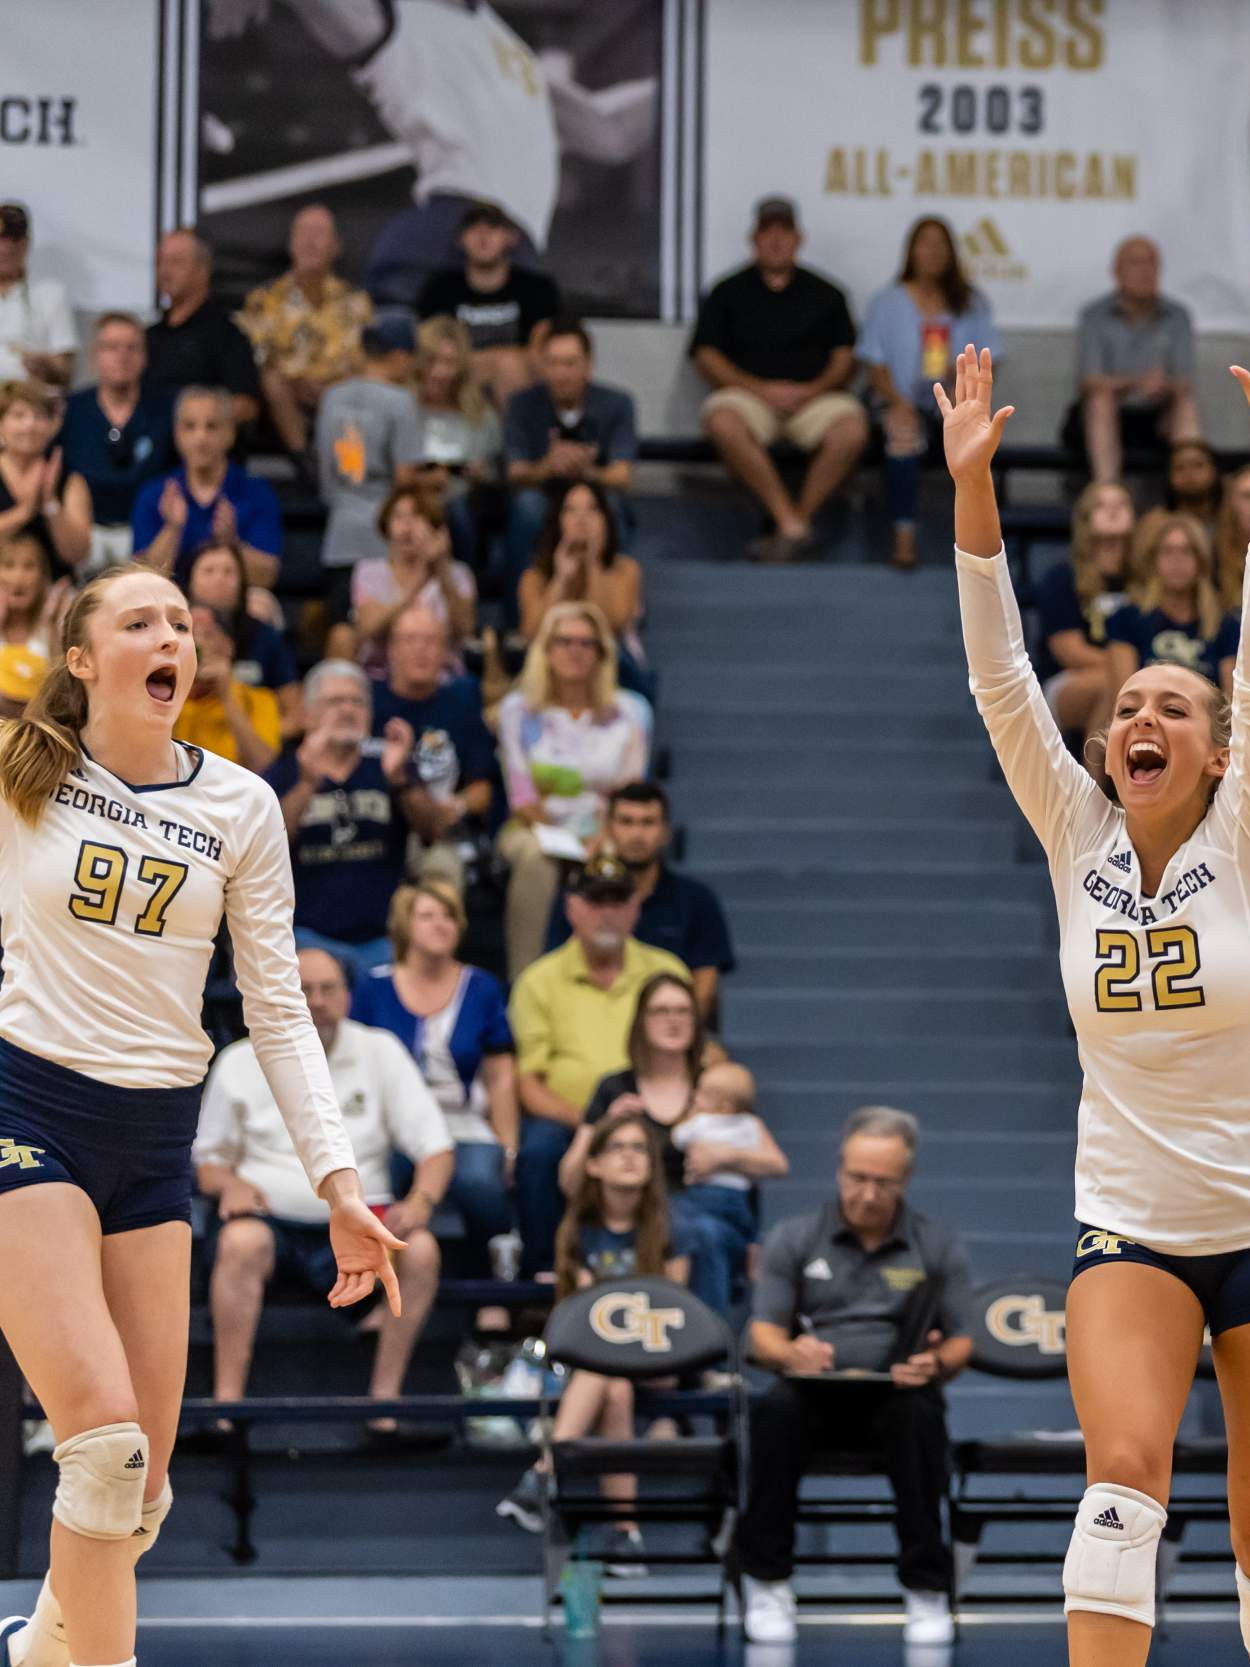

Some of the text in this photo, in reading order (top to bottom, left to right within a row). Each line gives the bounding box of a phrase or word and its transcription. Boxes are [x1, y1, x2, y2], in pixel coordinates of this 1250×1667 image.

[857, 0, 1106, 70] PREISS
[0, 98, 79, 145] CH
[917, 83, 1043, 135] 2003
[824, 146, 1137, 200] ALL-AMERICAN
[51, 783, 223, 861] EORGIA TECH
[68, 840, 189, 937] 97
[1107, 856, 1131, 873] adidas
[1161, 862, 1216, 914] TECH
[1094, 925, 1206, 1012] 22
[1076, 1230, 1136, 1258] GT
[588, 1291, 686, 1353] GT
[984, 1294, 1067, 1355] GT
[1093, 1517, 1124, 1530] adidas
